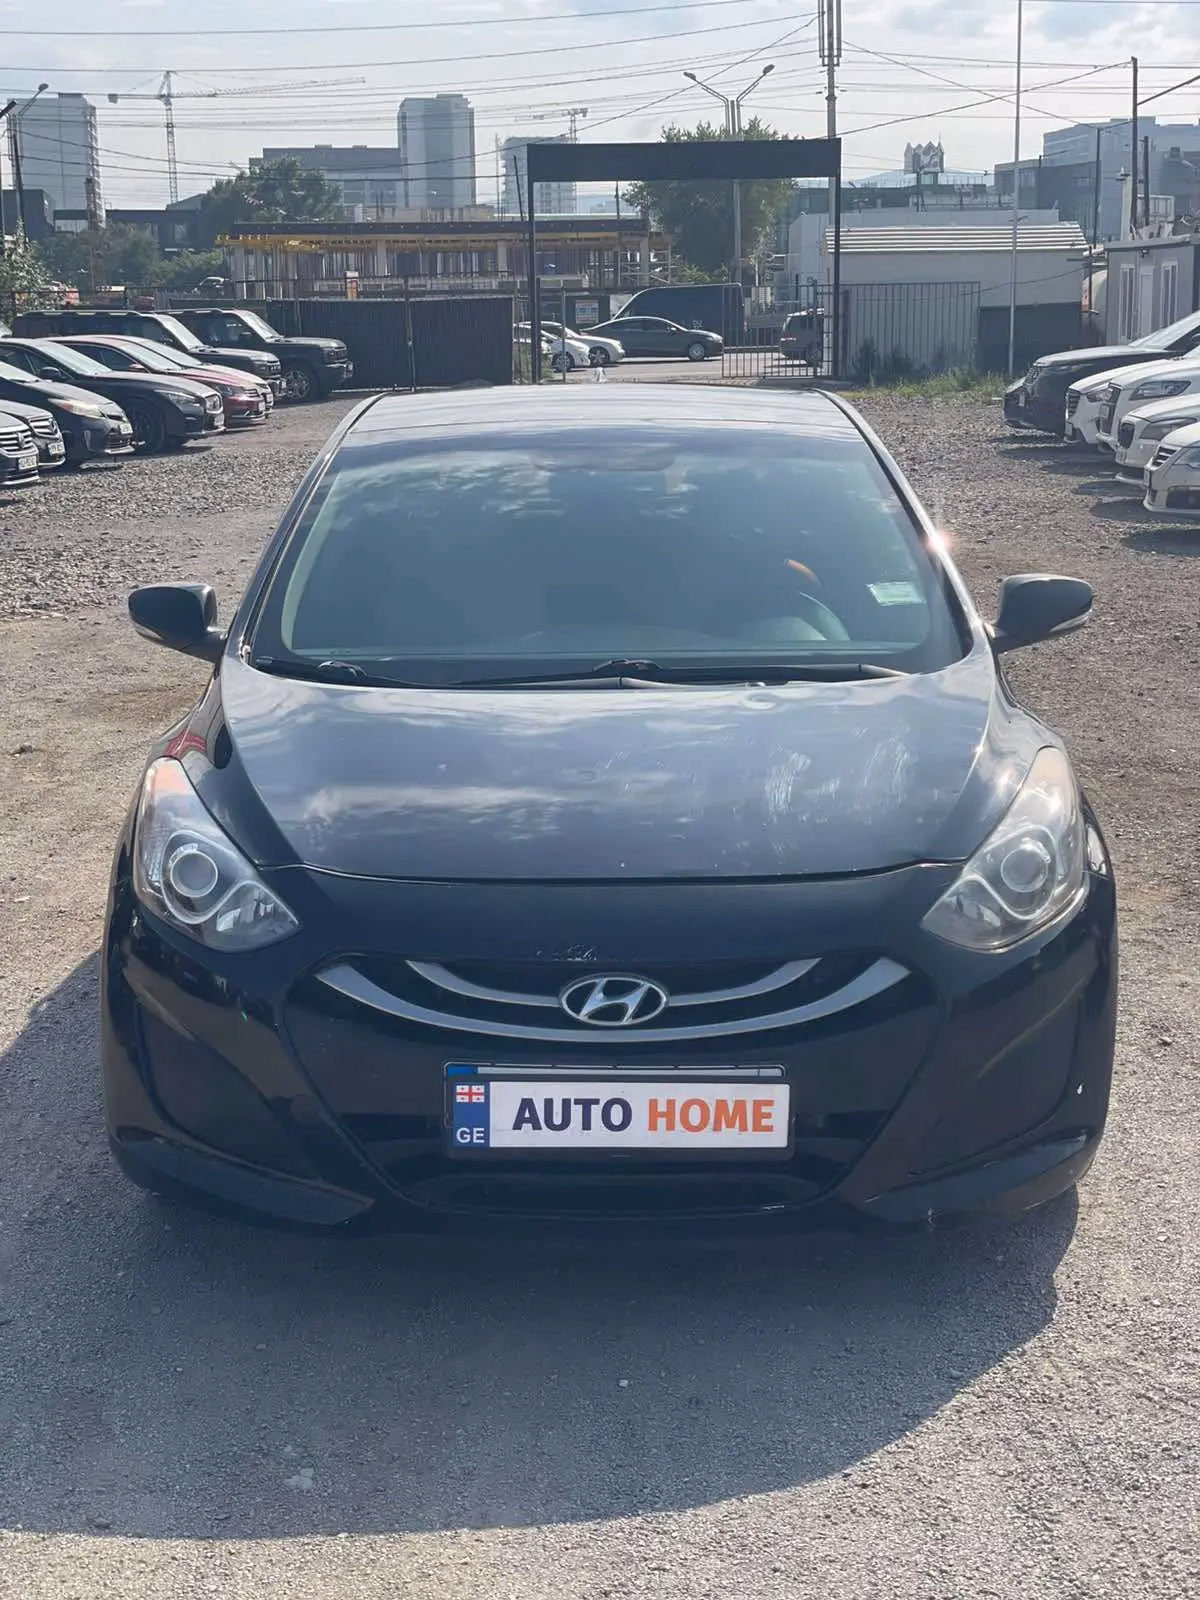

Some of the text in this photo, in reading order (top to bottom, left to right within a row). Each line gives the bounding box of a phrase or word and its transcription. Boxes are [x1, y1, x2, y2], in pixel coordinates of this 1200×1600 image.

[512, 1097, 775, 1133] AUTO HOME
[456, 1128, 485, 1144] GE
